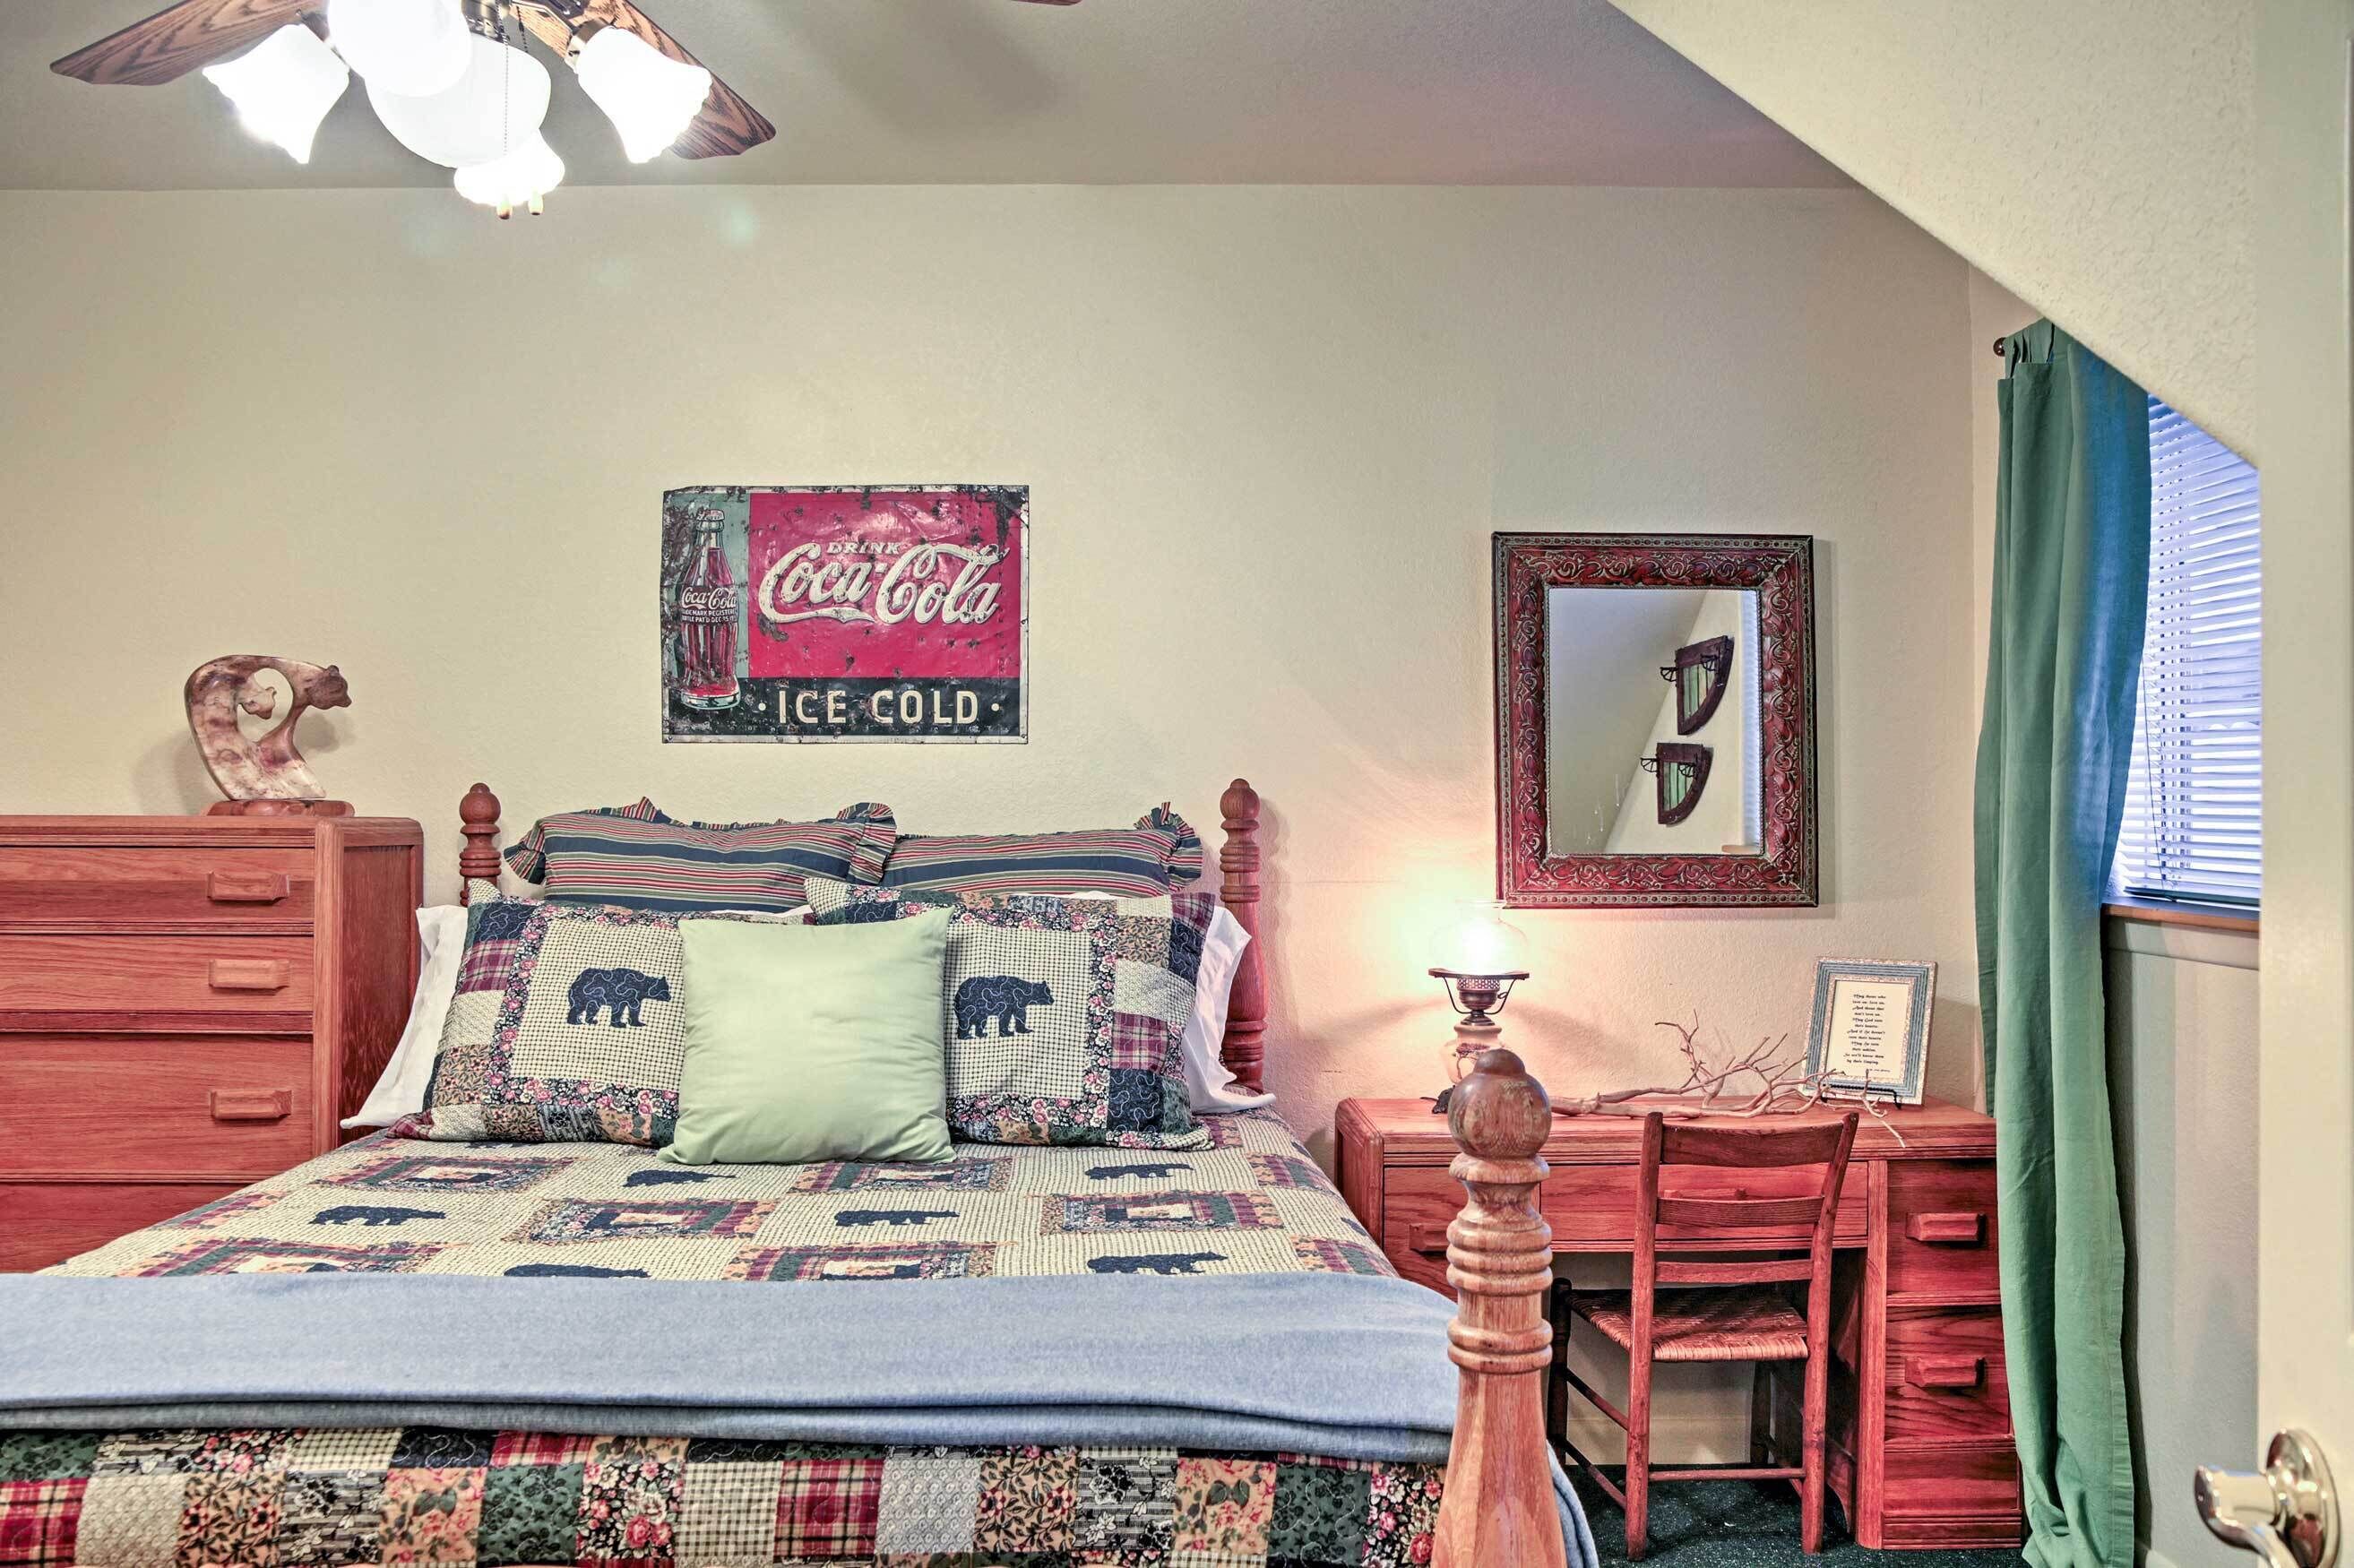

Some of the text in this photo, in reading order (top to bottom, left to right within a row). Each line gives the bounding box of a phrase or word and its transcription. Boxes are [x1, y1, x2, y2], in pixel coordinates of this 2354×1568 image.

[827, 542, 901, 554] DRINK
[758, 543, 1011, 624] Coca-Cola
[682, 587, 737, 610] Coca-Cola
[779, 690, 979, 724] ICE COLD
